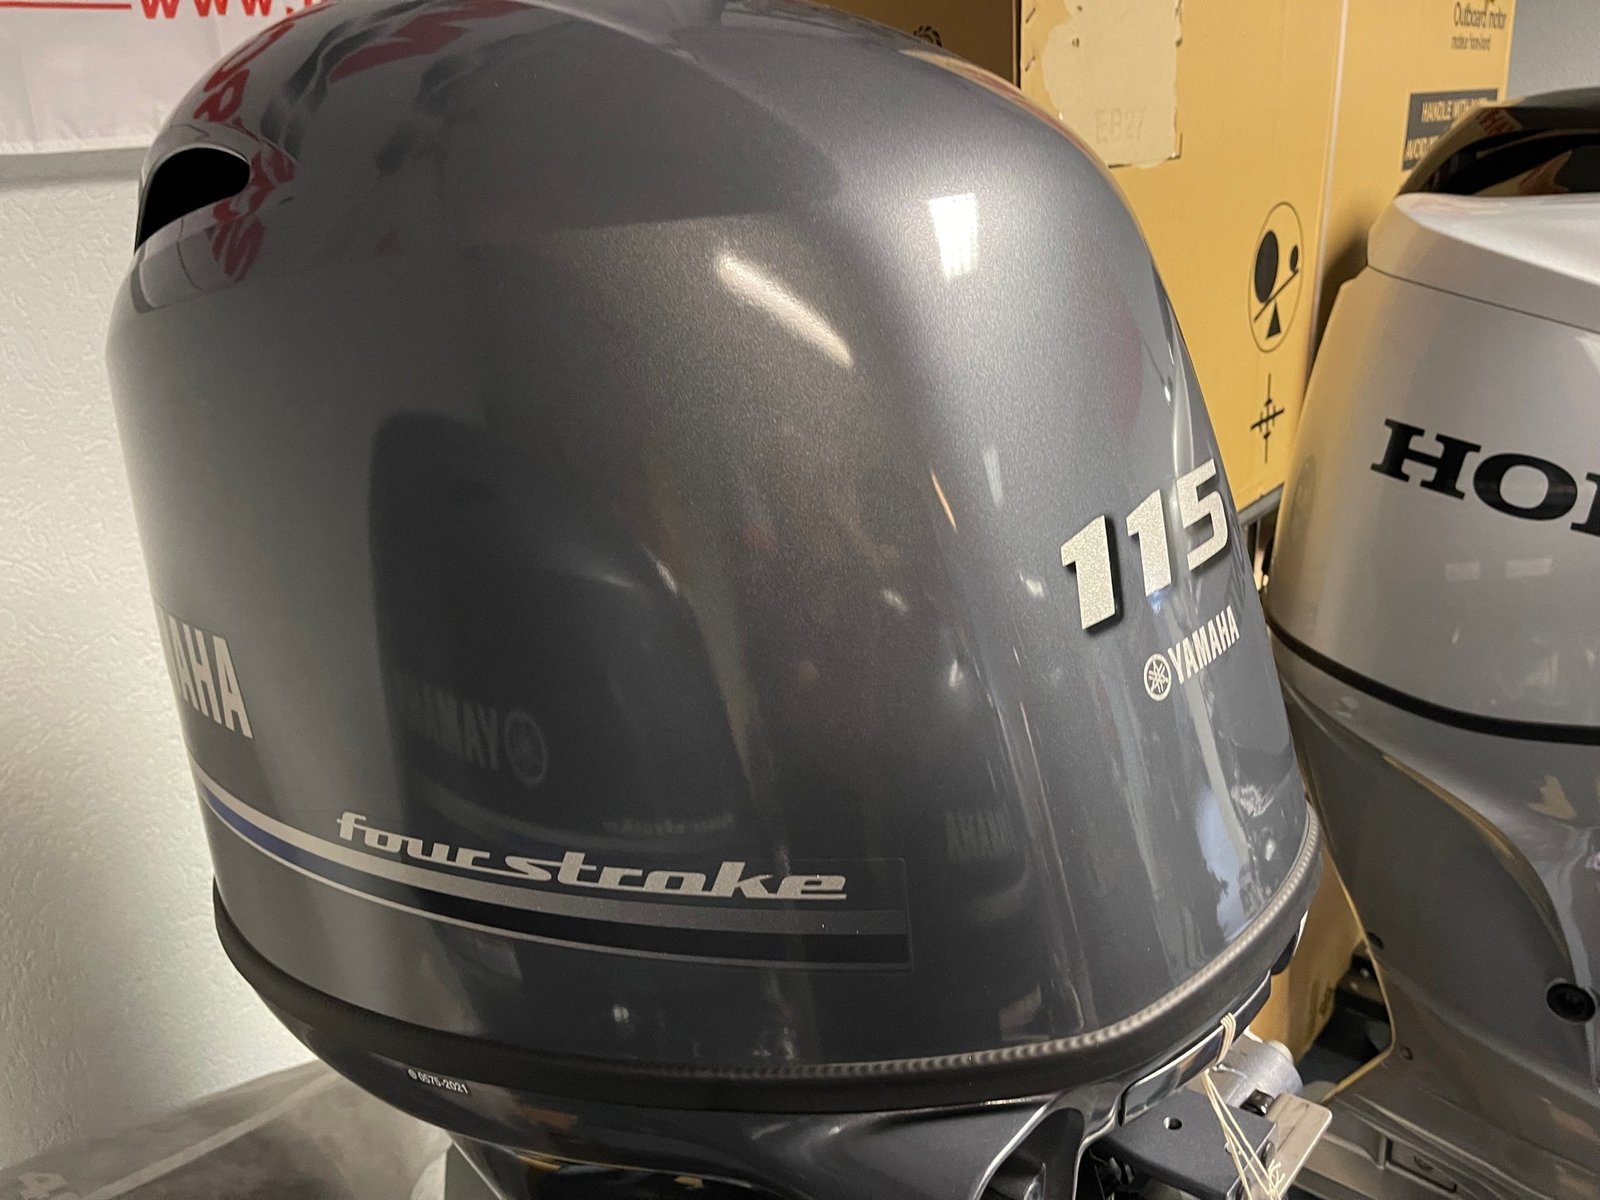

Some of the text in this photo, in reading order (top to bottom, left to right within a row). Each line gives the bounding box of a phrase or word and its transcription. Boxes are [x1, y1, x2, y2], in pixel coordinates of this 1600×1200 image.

[1370, 418, 1600, 538] HO
[1060, 457, 1229, 630] 115
[1167, 604, 1240, 685] YAMAHA
